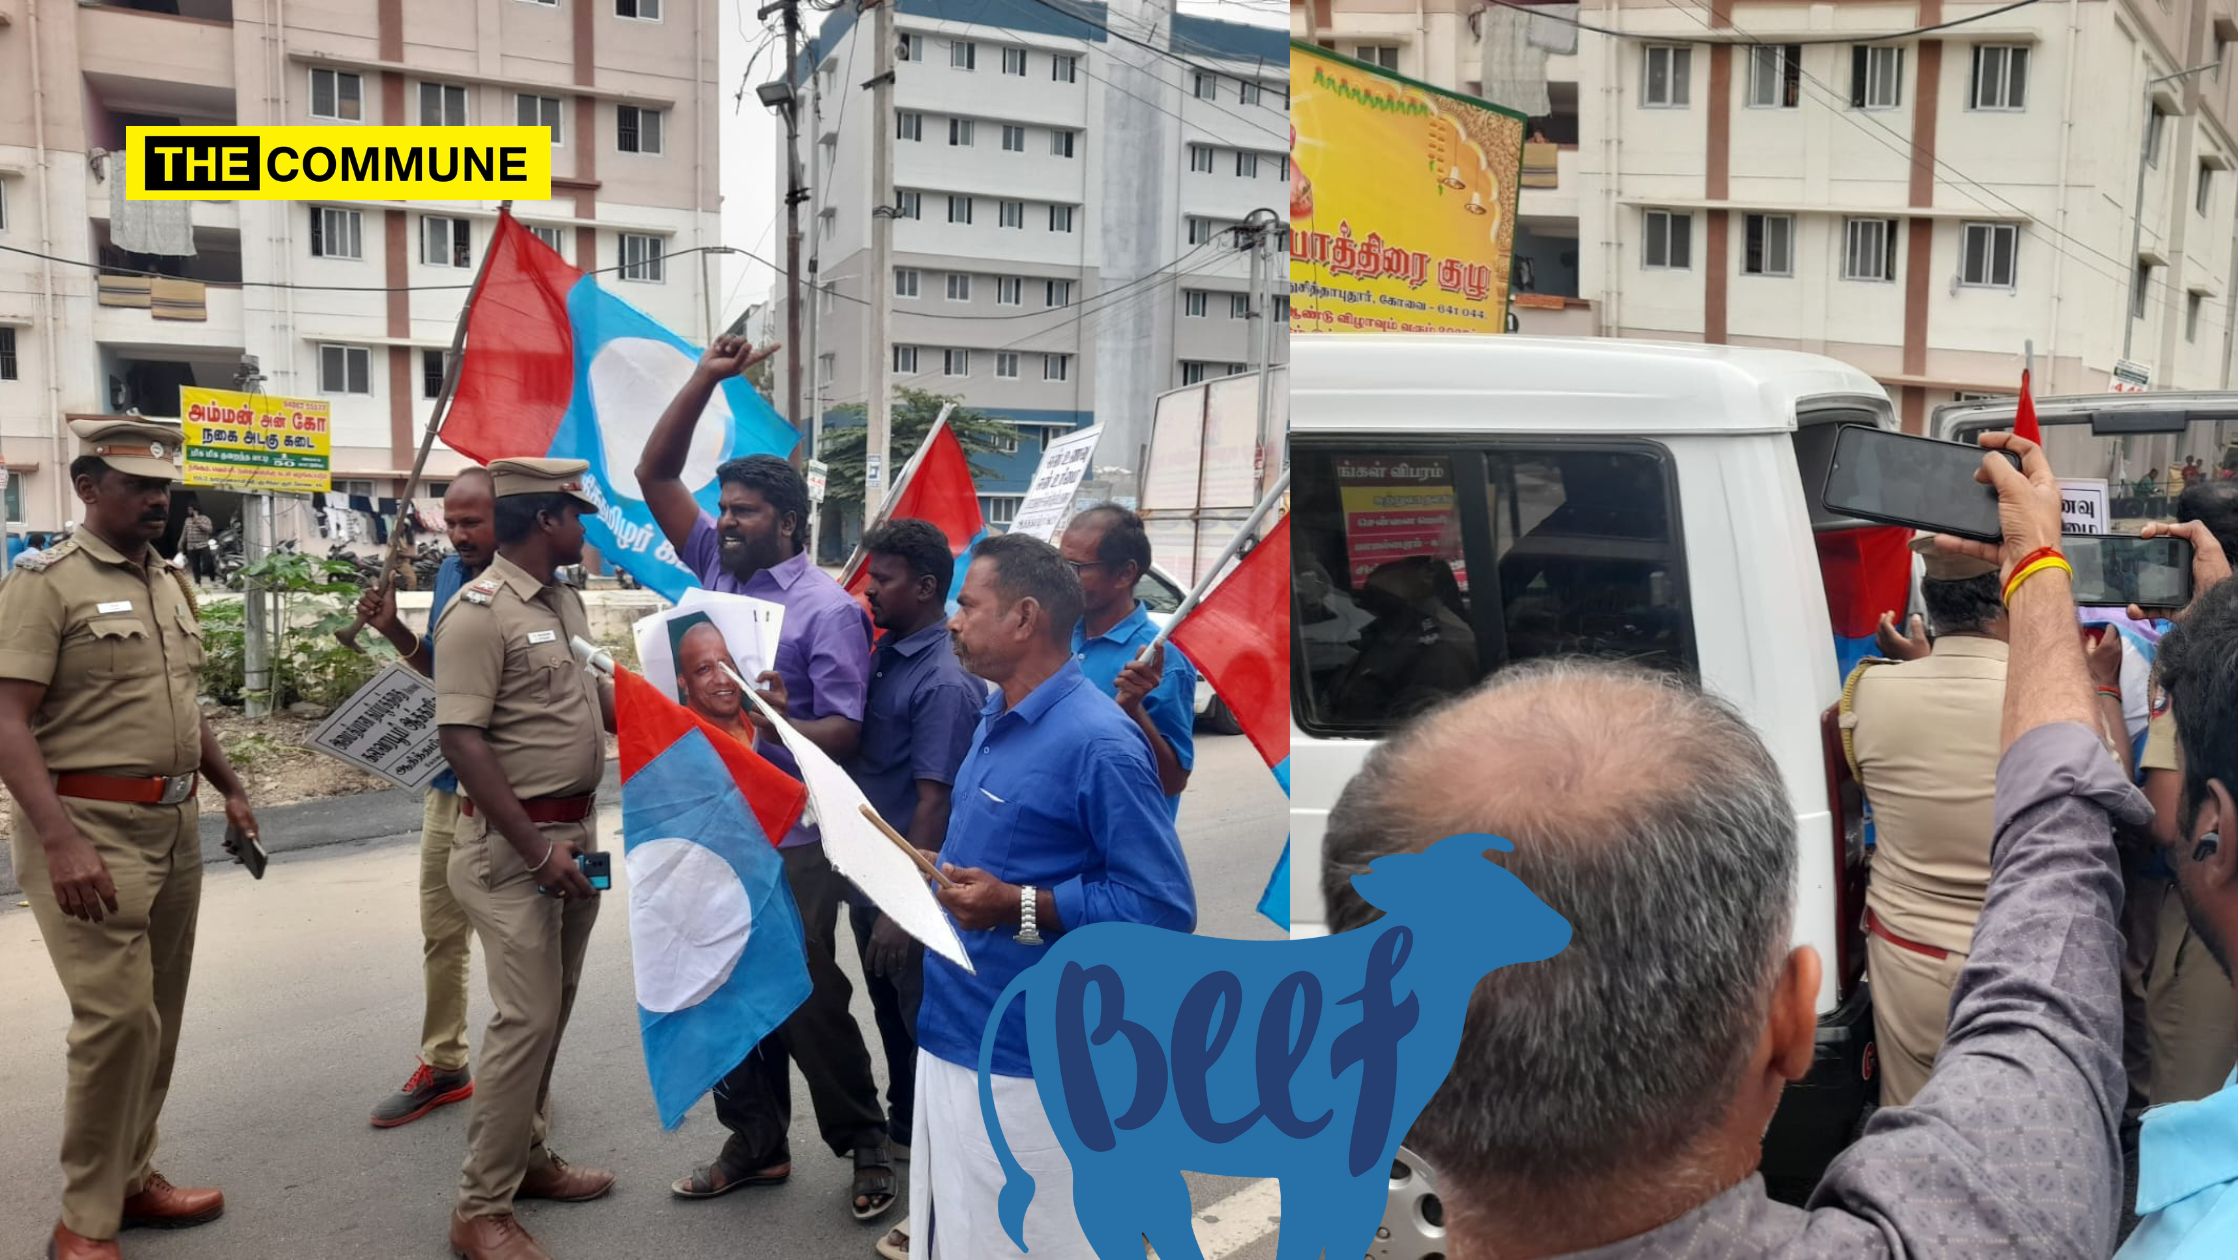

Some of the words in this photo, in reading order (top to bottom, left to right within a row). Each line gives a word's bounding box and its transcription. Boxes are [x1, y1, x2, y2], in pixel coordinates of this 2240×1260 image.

[1438, 258, 1492, 302] குழு
[1379, 294, 1427, 311] கோவை
[1437, 304, 1459, 316] 641
[1337, 312, 1398, 333] விழாவும்
[188, 401, 254, 427] அம்மன்
[260, 412, 287, 429] அன்
[292, 411, 327, 432] கோ
[202, 428, 238, 444] நகை
[243, 431, 279, 450] அடகு
[284, 435, 315, 449] கடை
[1390, 462, 1445, 481] விபரம்
